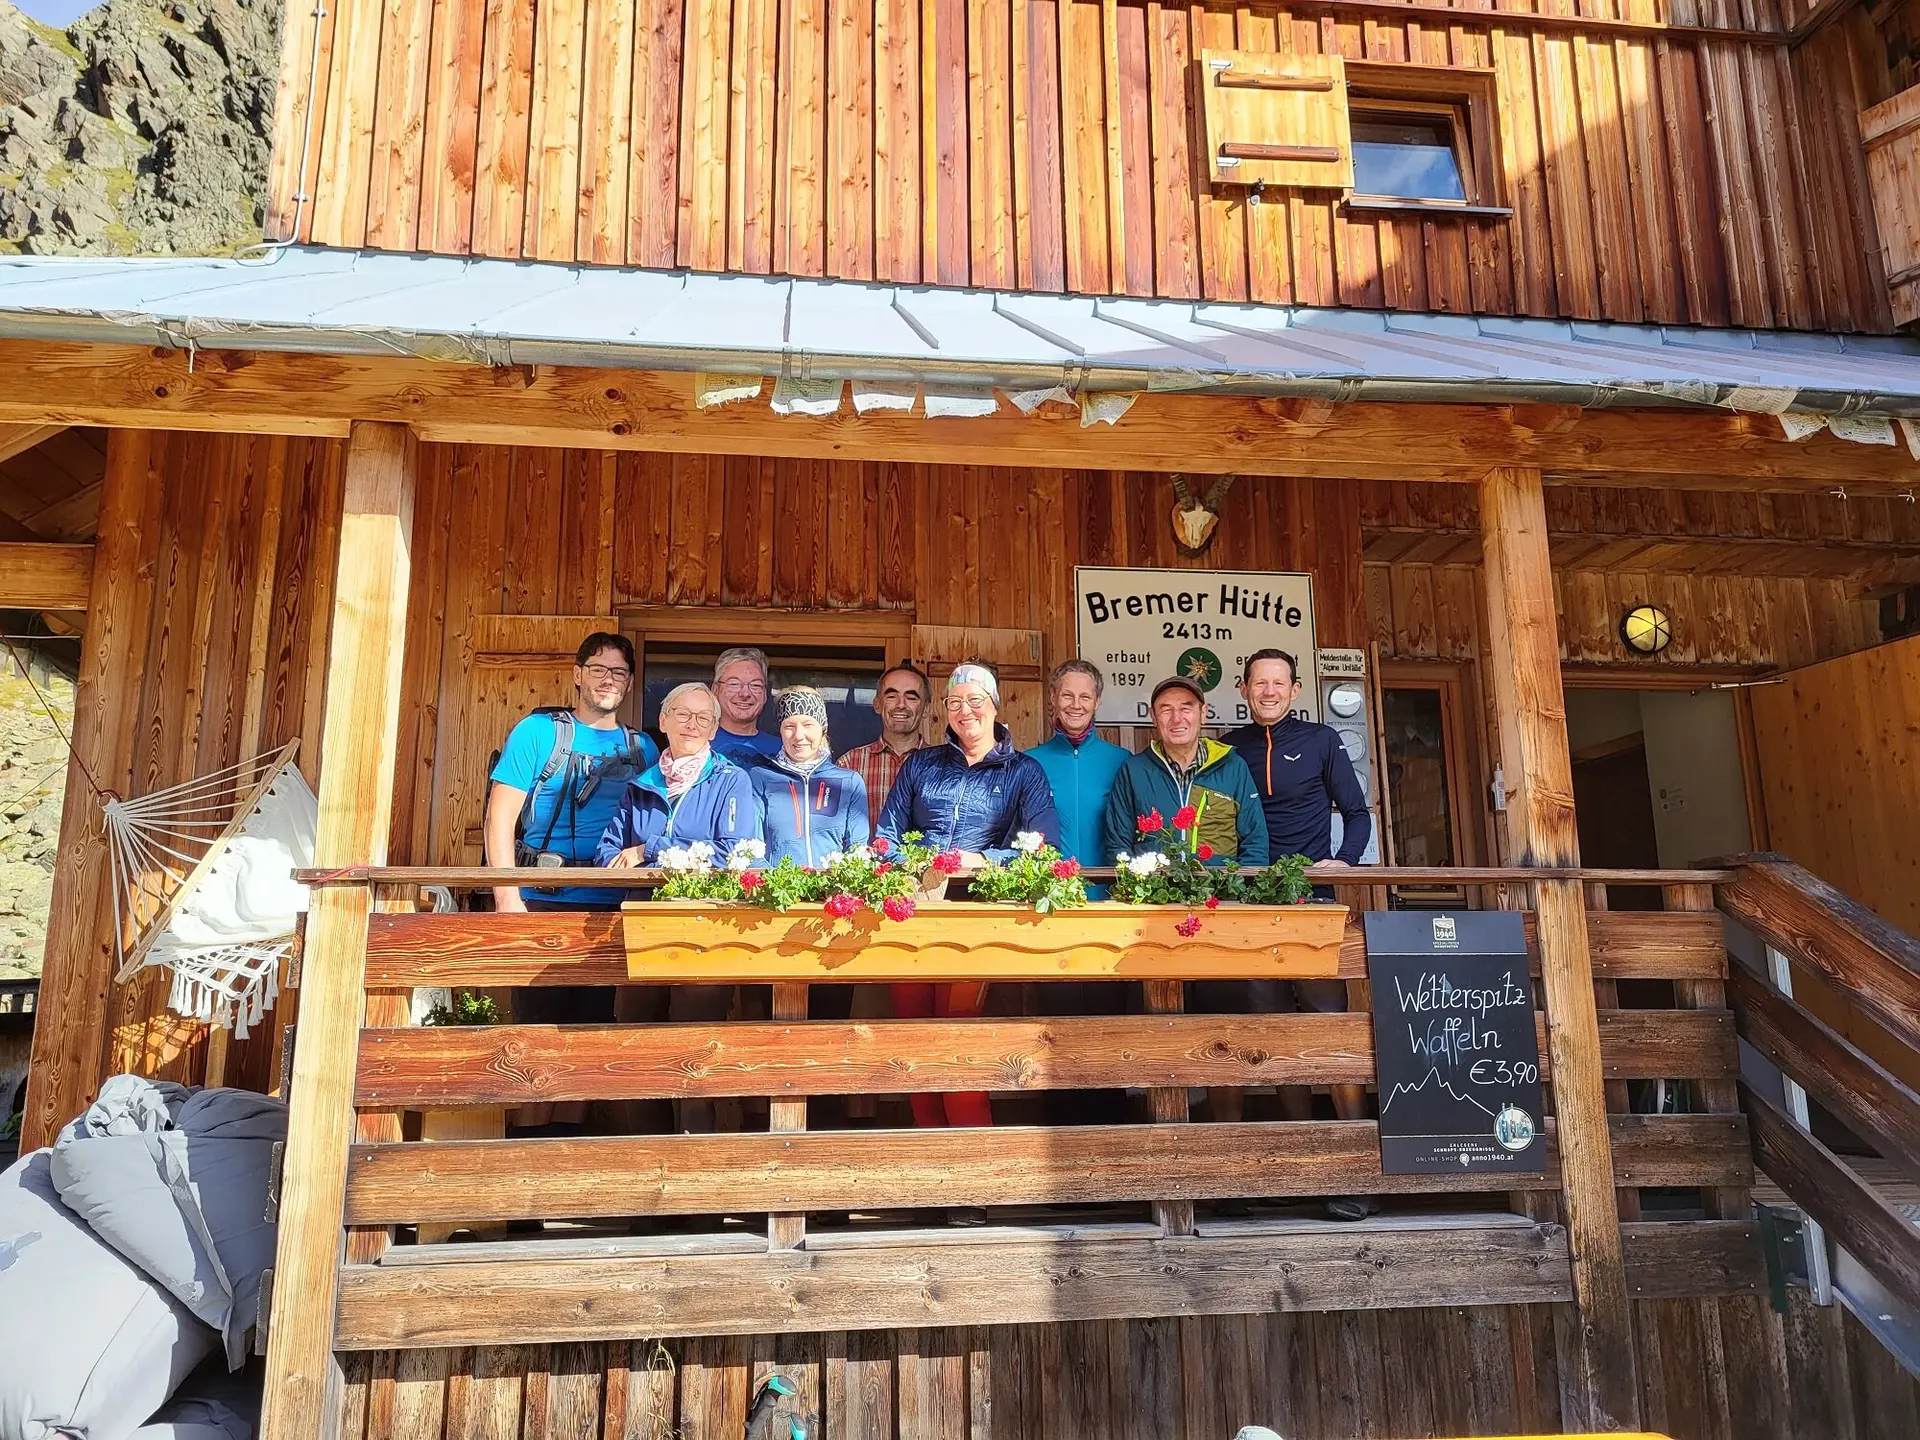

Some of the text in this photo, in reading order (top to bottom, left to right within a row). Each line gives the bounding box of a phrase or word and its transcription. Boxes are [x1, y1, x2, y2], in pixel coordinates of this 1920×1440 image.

[1085, 584, 1302, 628] Bremer Hütte
[1106, 650, 1151, 664] erbaut
[1320, 653, 1363, 663] Meldestelle für
[1111, 673, 1146, 687] 1897
[1436, 931, 1453, 939] 1940
[1395, 971, 1526, 1018] Wetterspitz
[1408, 1017, 1502, 1066] Waffeln
[1470, 1059, 1538, 1087] €3,90
[1471, 1154, 1514, 1162] anno1940.at
